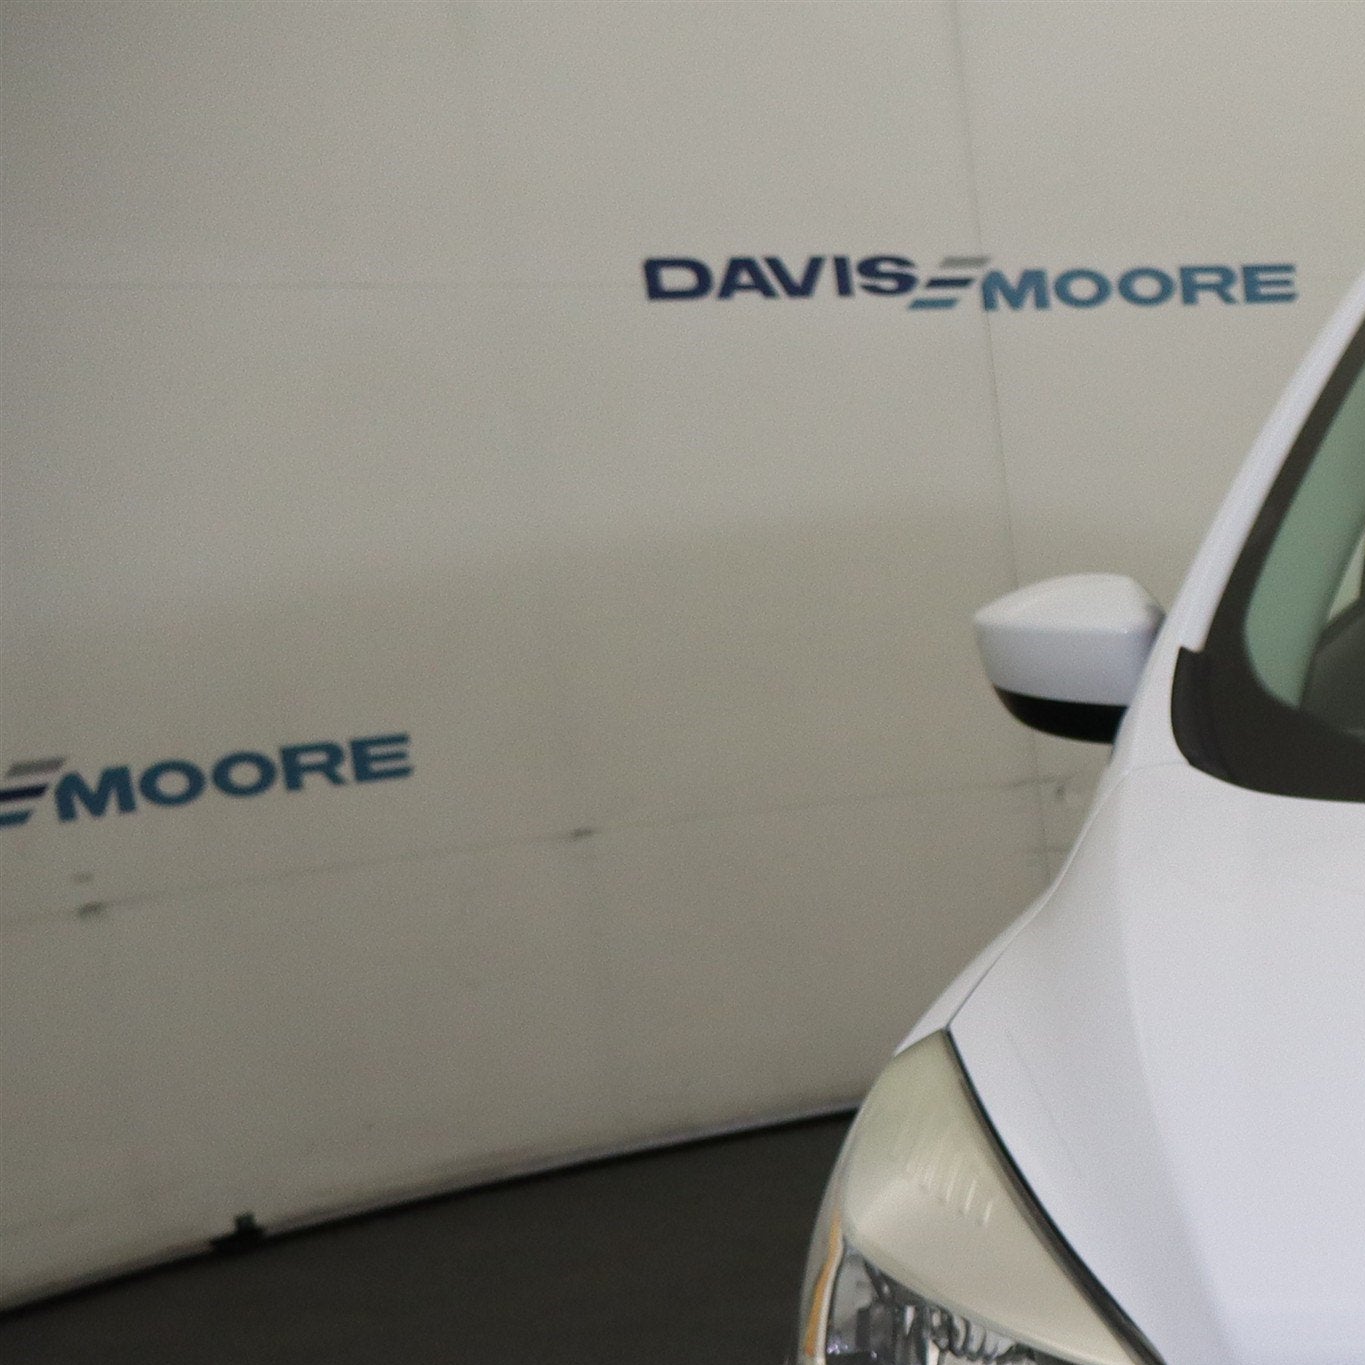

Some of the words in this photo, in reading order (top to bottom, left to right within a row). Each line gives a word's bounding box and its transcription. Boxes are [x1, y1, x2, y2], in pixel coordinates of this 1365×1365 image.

[643, 255, 917, 300] DAVIS
[981, 264, 1298, 311] MOORE
[54, 732, 415, 824] MOORE
